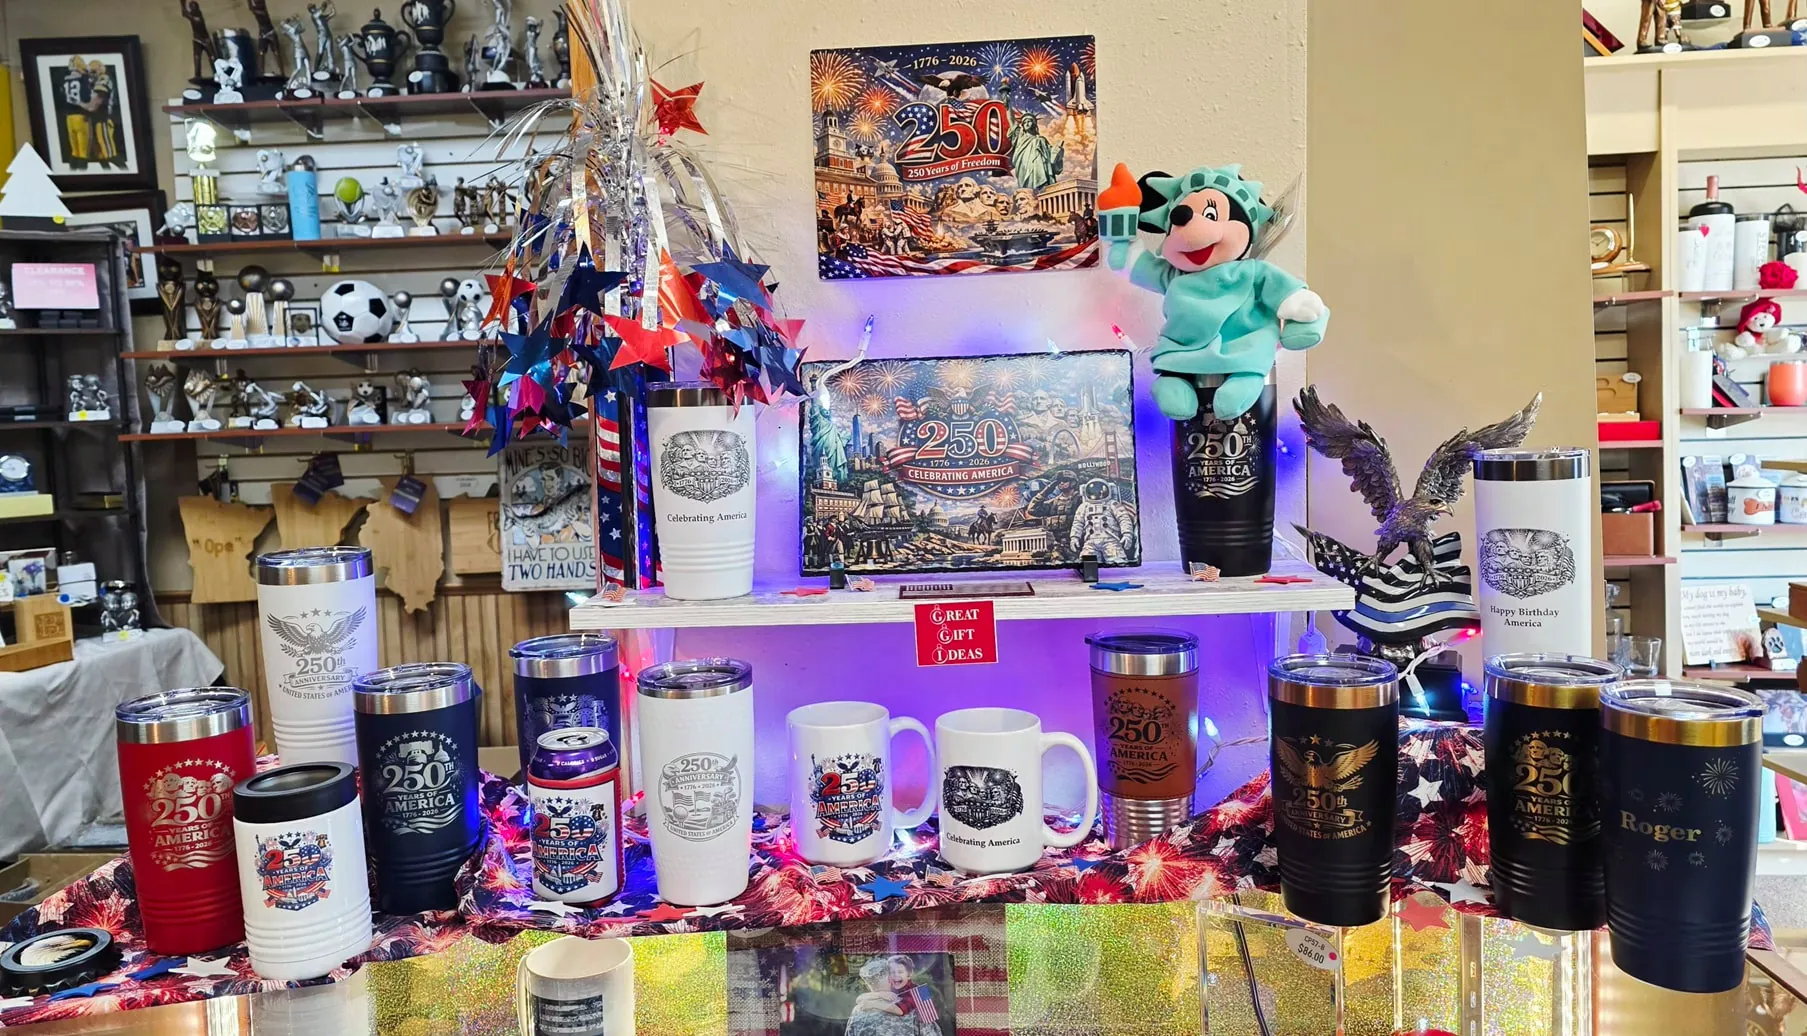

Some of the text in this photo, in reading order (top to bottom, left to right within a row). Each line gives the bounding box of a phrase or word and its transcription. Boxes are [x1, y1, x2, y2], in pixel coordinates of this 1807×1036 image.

[914, 56, 939, 69] 1776
[949, 55, 977, 66] 2026
[892, 101, 1014, 162] 250
[908, 157, 1001, 178] 250 Years of Freedom
[915, 418, 1008, 459] 250
[550, 446, 569, 463] SO
[930, 459, 950, 468] 1776
[908, 466, 1014, 481] CELEBRATING AMERICA
[1189, 465, 1252, 478] AMERICA
[667, 512, 747, 524] Celebrating America
[507, 546, 595, 562] I HAVE TO USE
[508, 561, 597, 581] TWO HANDS
[1695, 588, 1708, 601] dog
[931, 608, 980, 622] GREAT
[1490, 605, 1559, 618] Happy Birthday
[1504, 618, 1542, 628] America
[939, 628, 975, 642] GIFT
[936, 648, 983, 661] IDEAS
[294, 675, 345, 685] ANNIVERSARY
[282, 686, 302, 699] UNITED
[303, 692, 325, 700] STATES
[1110, 748, 1168, 761] AMERICA
[675, 773, 724, 784] ANNIVERSARY
[820, 768, 877, 796] 250
[385, 793, 455, 814] AMERICA
[397, 793, 424, 801] YEARS
[1531, 796, 1562, 806] YEARS
[422, 809, 438, 817] 2026
[816, 795, 882, 818] AMERICA
[1515, 800, 1571, 817] AMERI
[1291, 809, 1347, 824] ANNIVERSARY
[168, 824, 200, 834] YEARS
[534, 812, 596, 840] 250
[669, 825, 688, 836] UNITED
[712, 821, 734, 835] AMERICA
[1298, 825, 1322, 839] STATES
[1331, 824, 1367, 840] AMERICA
[1620, 809, 1702, 843] Roger
[154, 825, 231, 848] AMERICA
[946, 832, 1021, 848] Celebrating America
[264, 844, 322, 871] 250
[532, 844, 601, 861] AMERICA
[263, 867, 330, 890] AMERICA
[1304, 935, 1326, 951] CP57-B
[1298, 943, 1325, 964] $86.00
